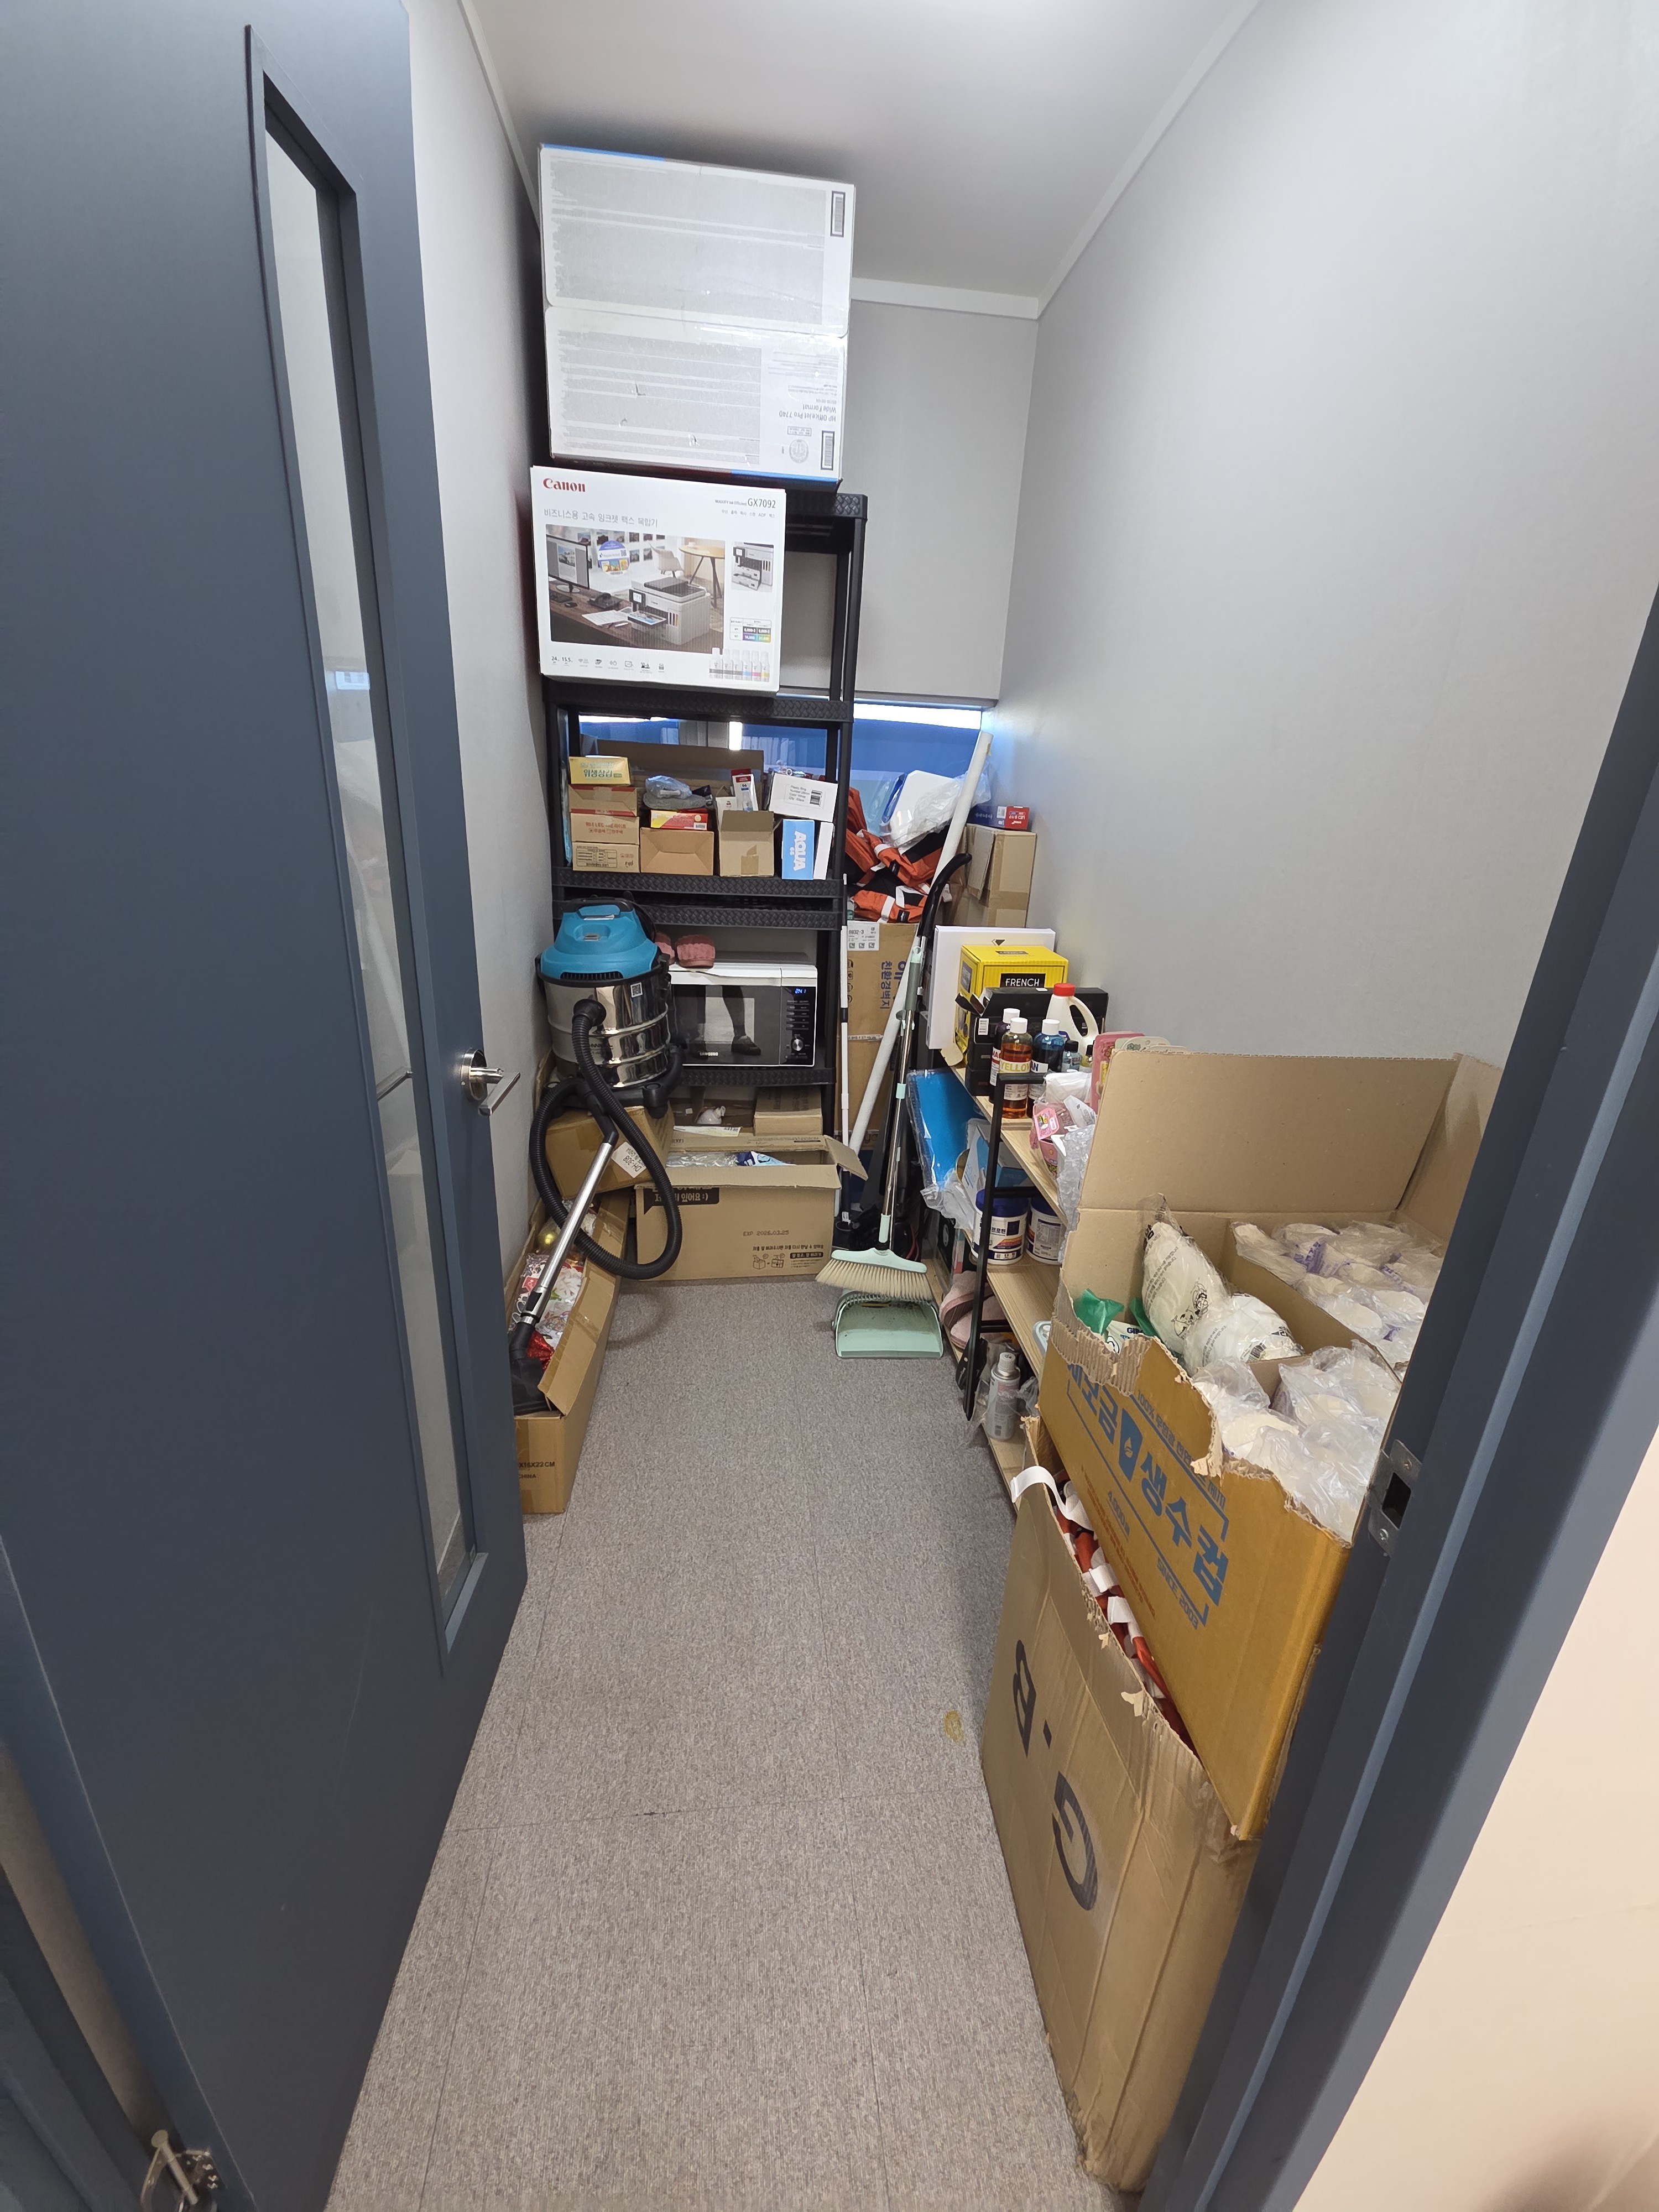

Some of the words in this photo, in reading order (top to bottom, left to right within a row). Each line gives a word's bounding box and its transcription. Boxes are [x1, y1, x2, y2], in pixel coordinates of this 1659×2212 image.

[802, 404, 822, 413] Format
[804, 413, 827, 421] OfficeJet
[543, 478, 586, 492] Canon
[748, 498, 776, 508] GX7092
[544, 508, 578, 520] 비즈니스용
[581, 510, 595, 521] 고속
[597, 512, 618, 524] 잉크젯
[793, 831, 807, 871] AQUA
[879, 961, 893, 1009] 친환경벽지
[1005, 978, 1040, 987] FRENCH
[623, 1155, 642, 1172] DH-308
[681, 1192, 701, 1202] 있어요
[1136, 1390, 1154, 1423] 100%
[1141, 1452, 1229, 1606] 생수컵
[1156, 1557, 1179, 1593] SINCE
[1178, 1590, 1199, 1630] 2003
